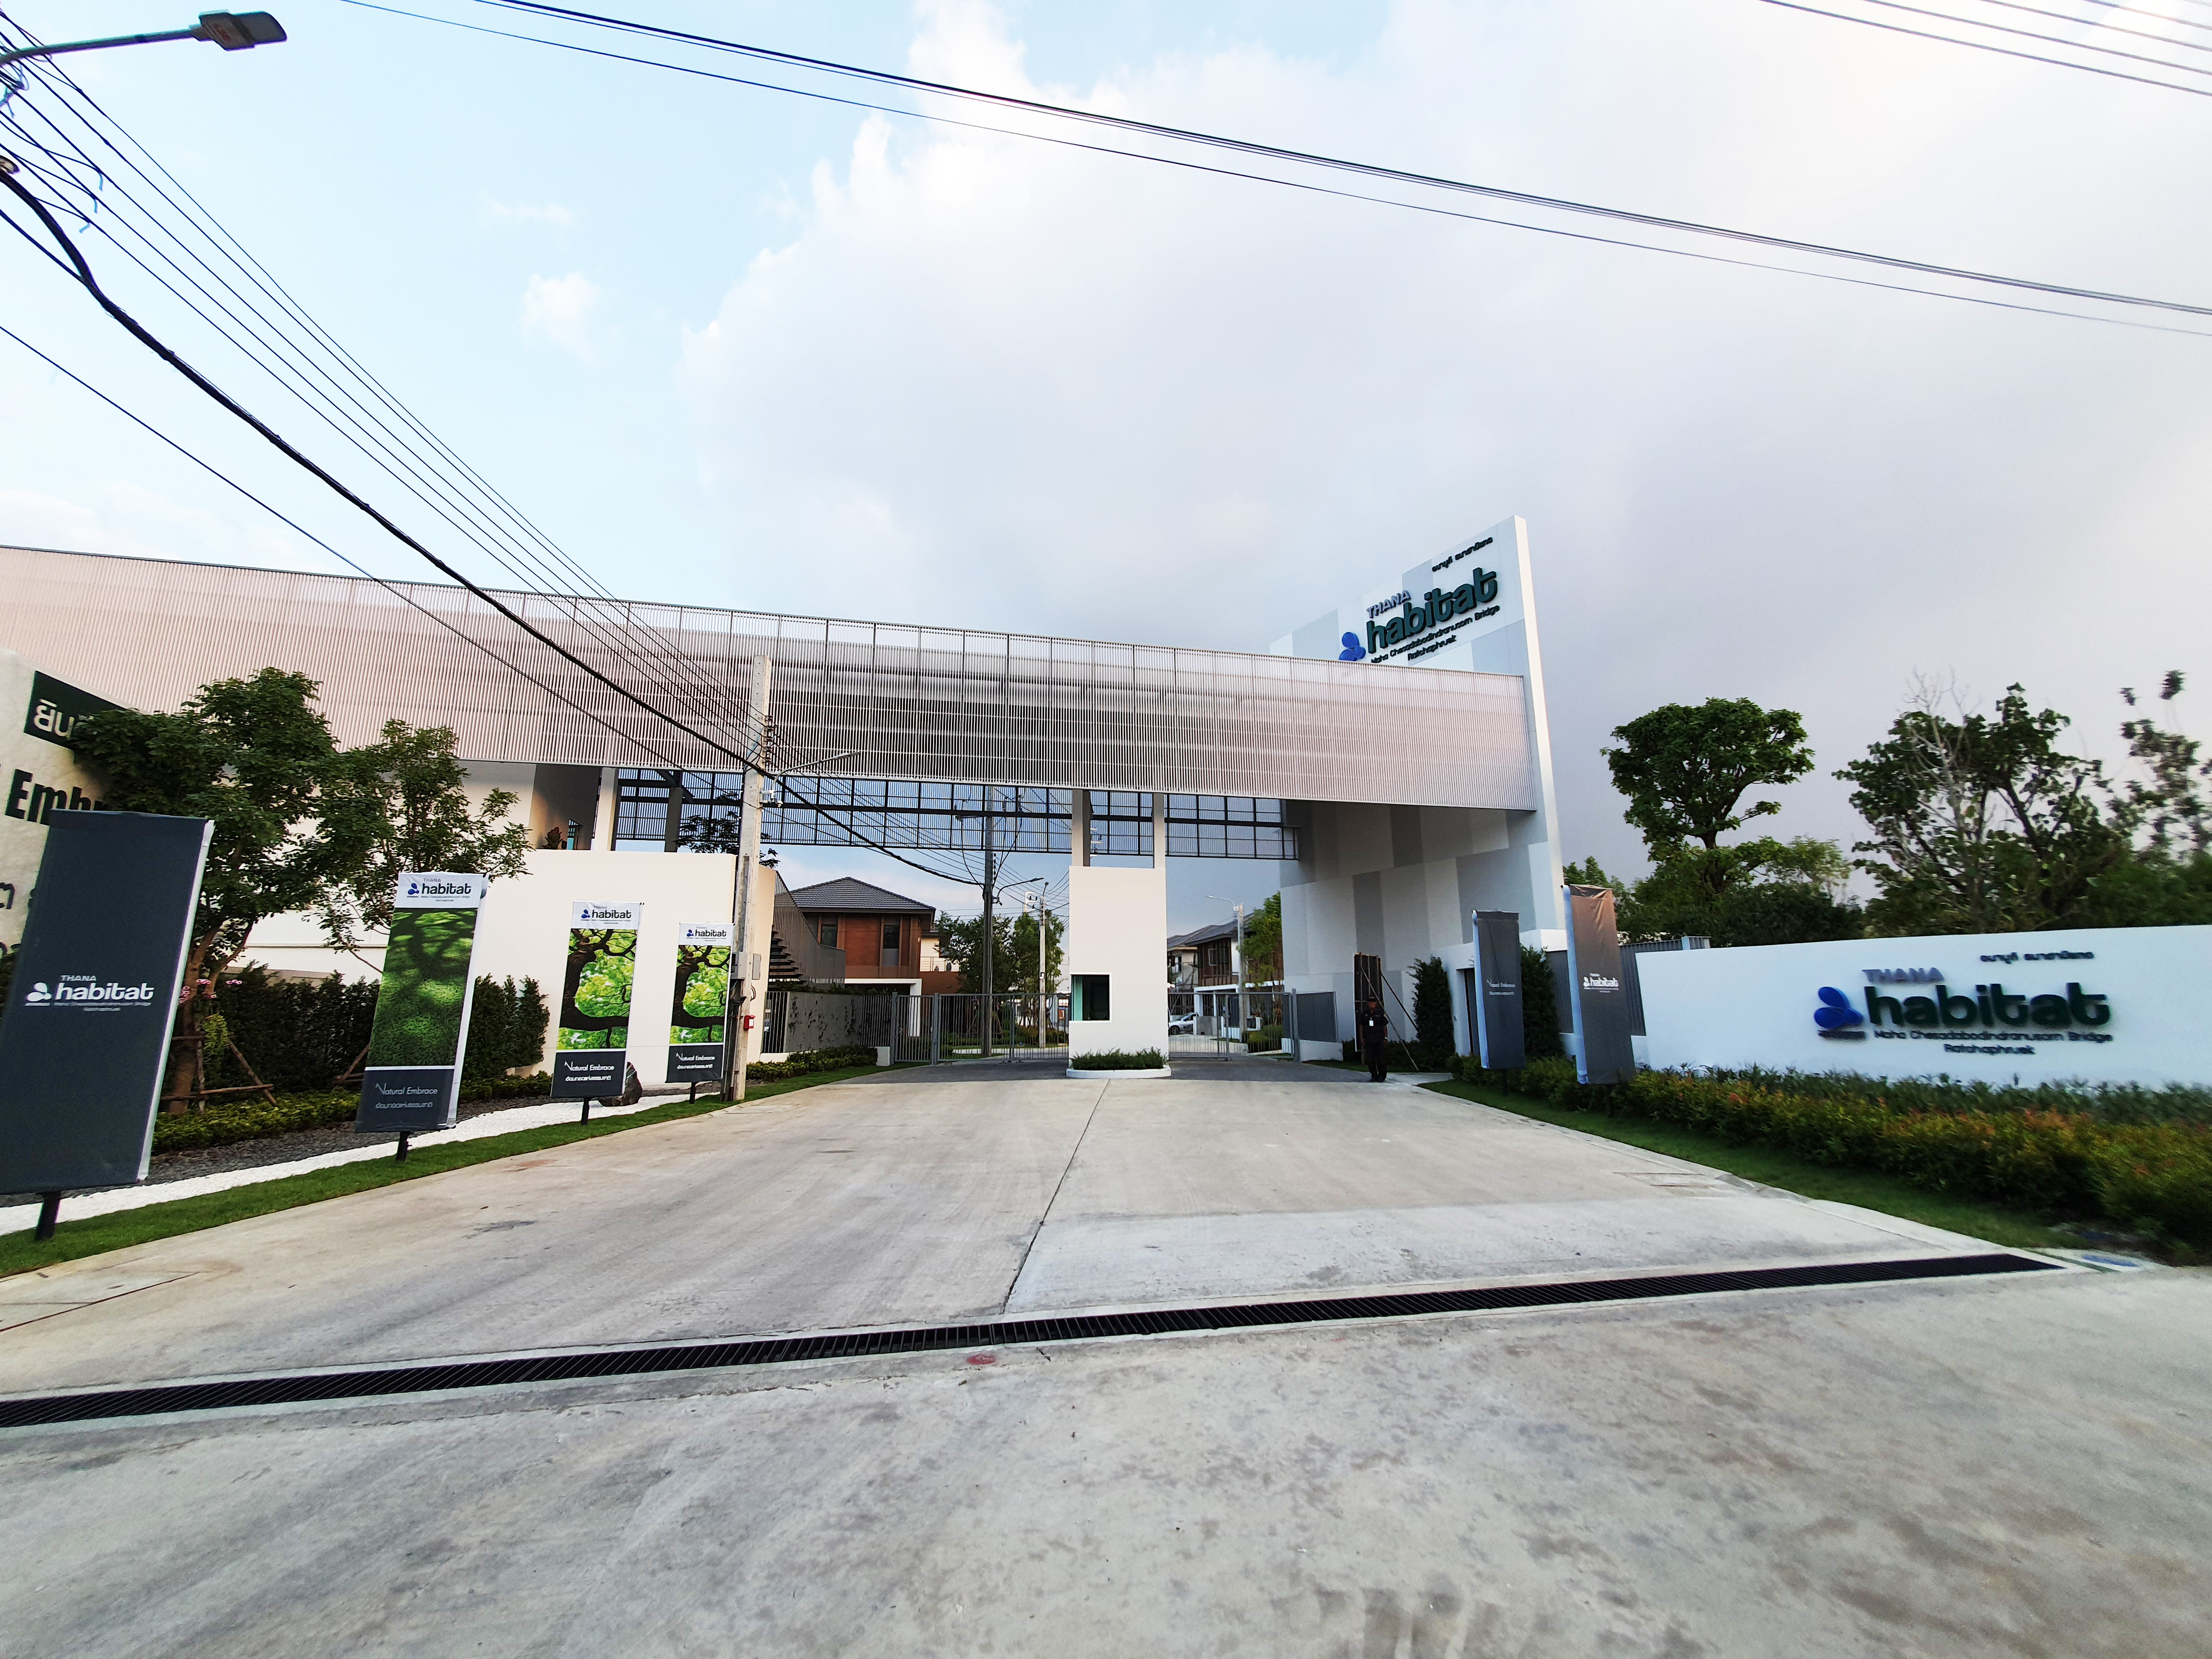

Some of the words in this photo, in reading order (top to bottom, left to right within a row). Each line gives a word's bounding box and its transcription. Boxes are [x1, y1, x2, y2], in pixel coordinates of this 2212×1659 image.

[1366, 589, 1411, 618] THANA
[1366, 567, 1498, 654] habitat
[1474, 605, 1500, 621] Bridge
[421, 883, 472, 894] habitat
[592, 909, 632, 918] habitat
[1862, 967, 1945, 984] THANA
[54, 982, 155, 1000] habitat
[1863, 982, 2111, 1027] habitat
[564, 1061, 589, 1071] Natural
[375, 1082, 405, 1094] Natural
[406, 1086, 438, 1094] Embrace
